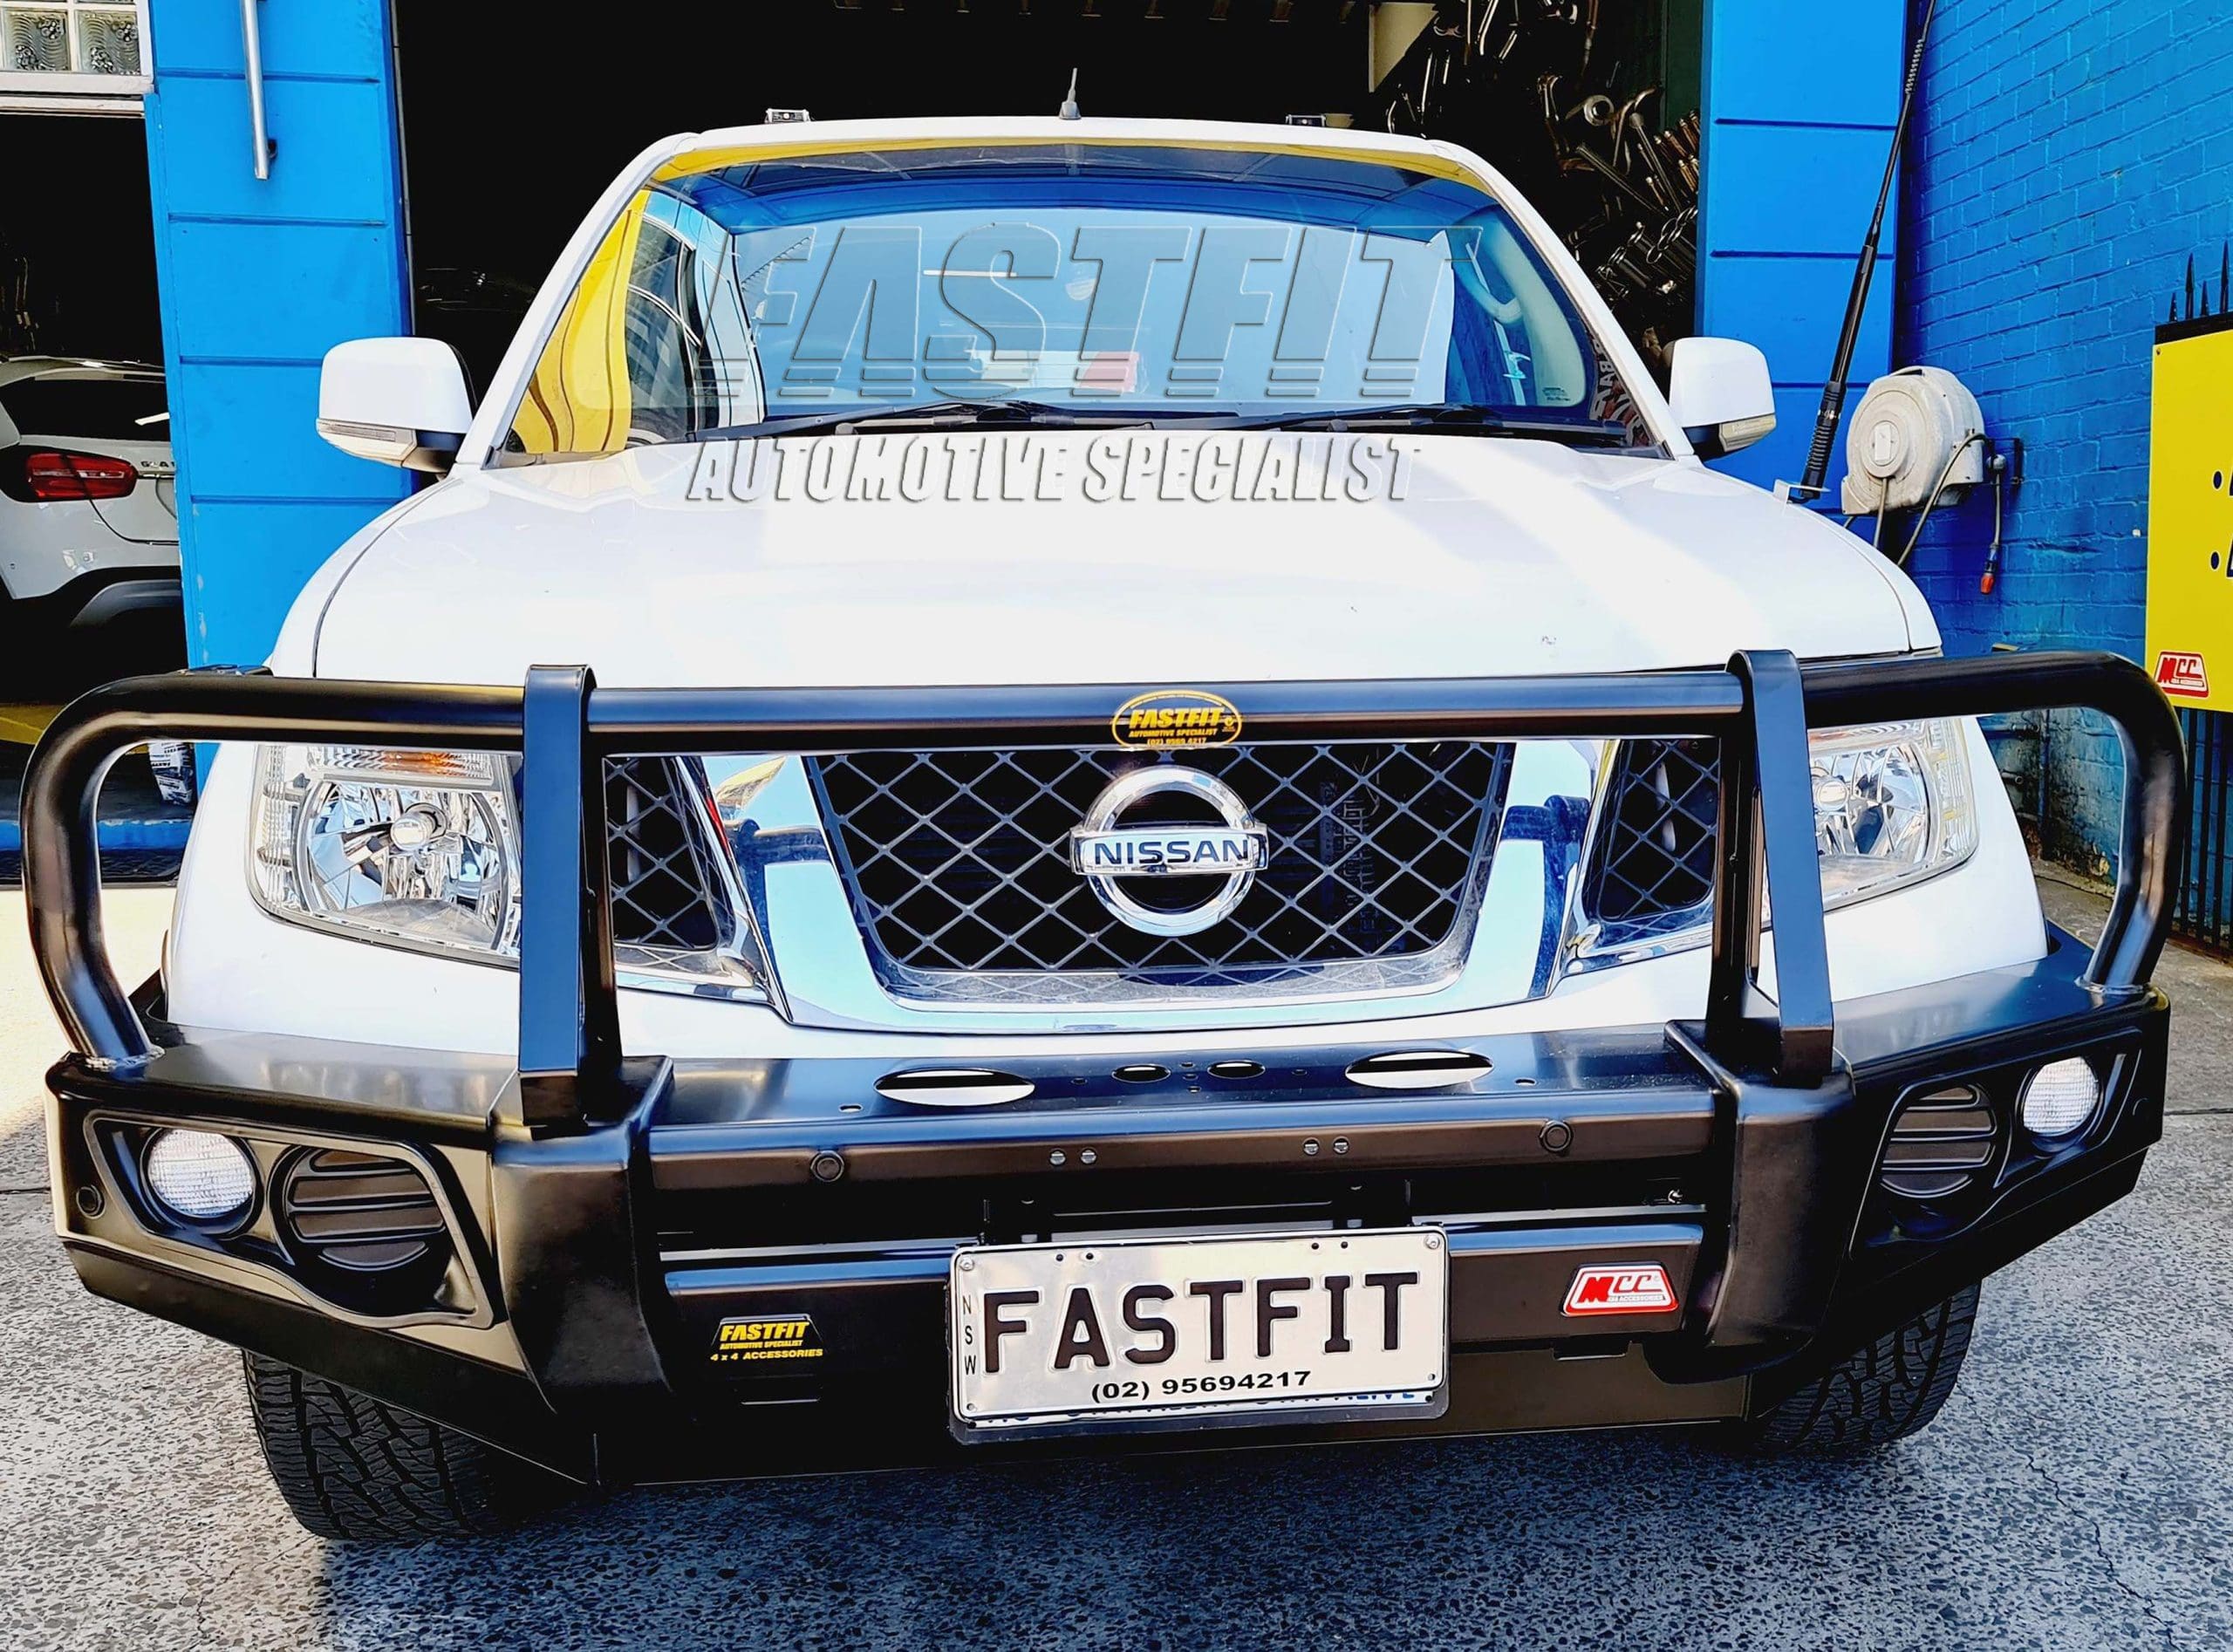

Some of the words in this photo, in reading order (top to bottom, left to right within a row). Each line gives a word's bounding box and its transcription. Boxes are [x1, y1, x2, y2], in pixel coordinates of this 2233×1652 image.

[1130, 707, 1225, 728] FASTFIT
[1130, 729, 1175, 738] AUTOMOTIVE
[1095, 839, 1249, 865] NISSAN
[720, 1321, 809, 1341] FASTFIT
[983, 1272, 1418, 1374] FASTFIT
[742, 1348, 823, 1360] ACCESSORIES
[764, 1340, 804, 1348] SPECIALIST
[1092, 1381, 1151, 1403] (02)
[1162, 1370, 1312, 1396] 95694217
